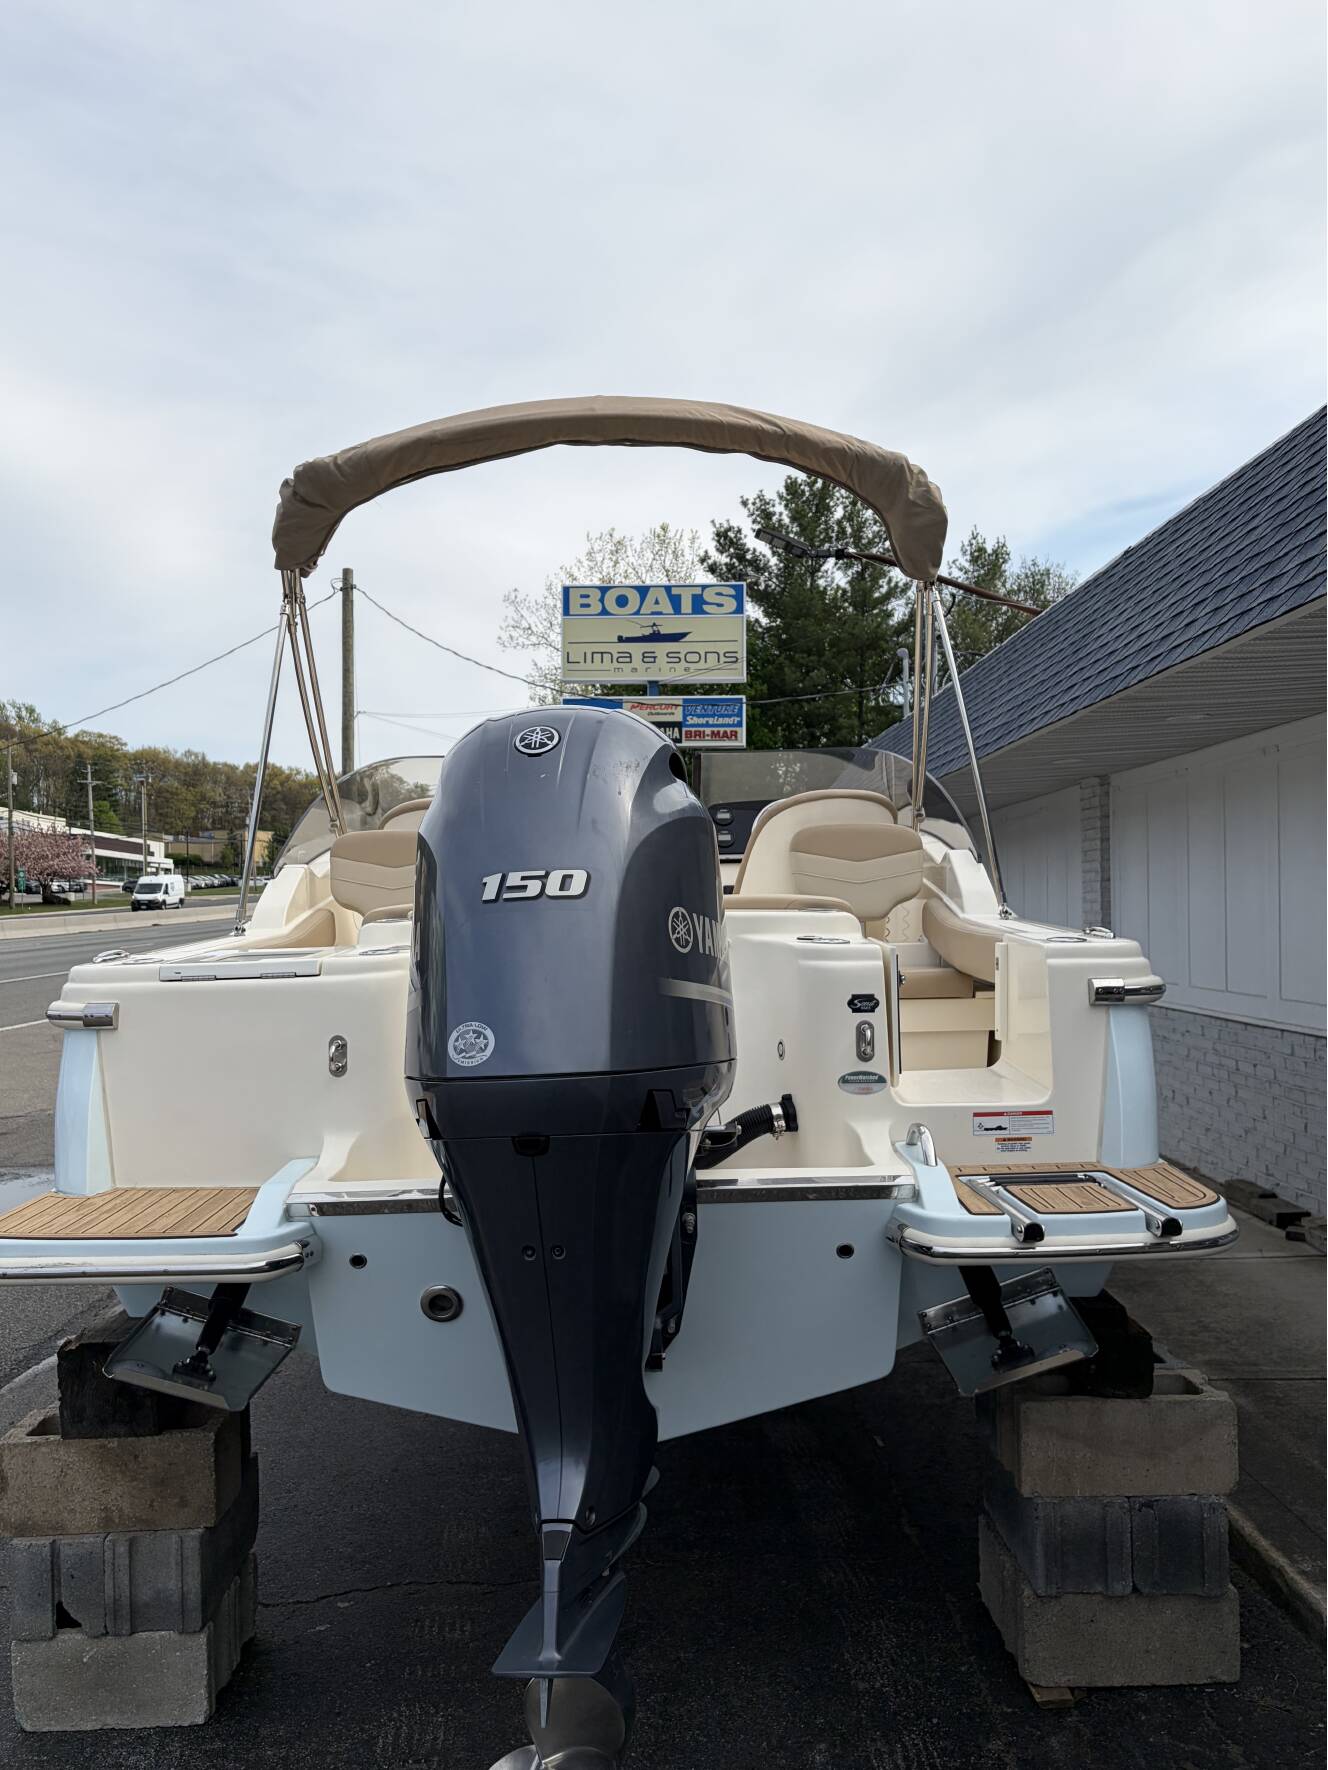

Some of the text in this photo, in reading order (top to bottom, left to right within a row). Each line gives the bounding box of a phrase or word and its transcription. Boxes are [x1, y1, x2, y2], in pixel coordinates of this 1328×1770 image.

[568, 586, 738, 615] BOATS
[641, 651, 658, 664] &
[684, 730, 738, 739] BRI-MAR
[481, 869, 590, 903] 150
